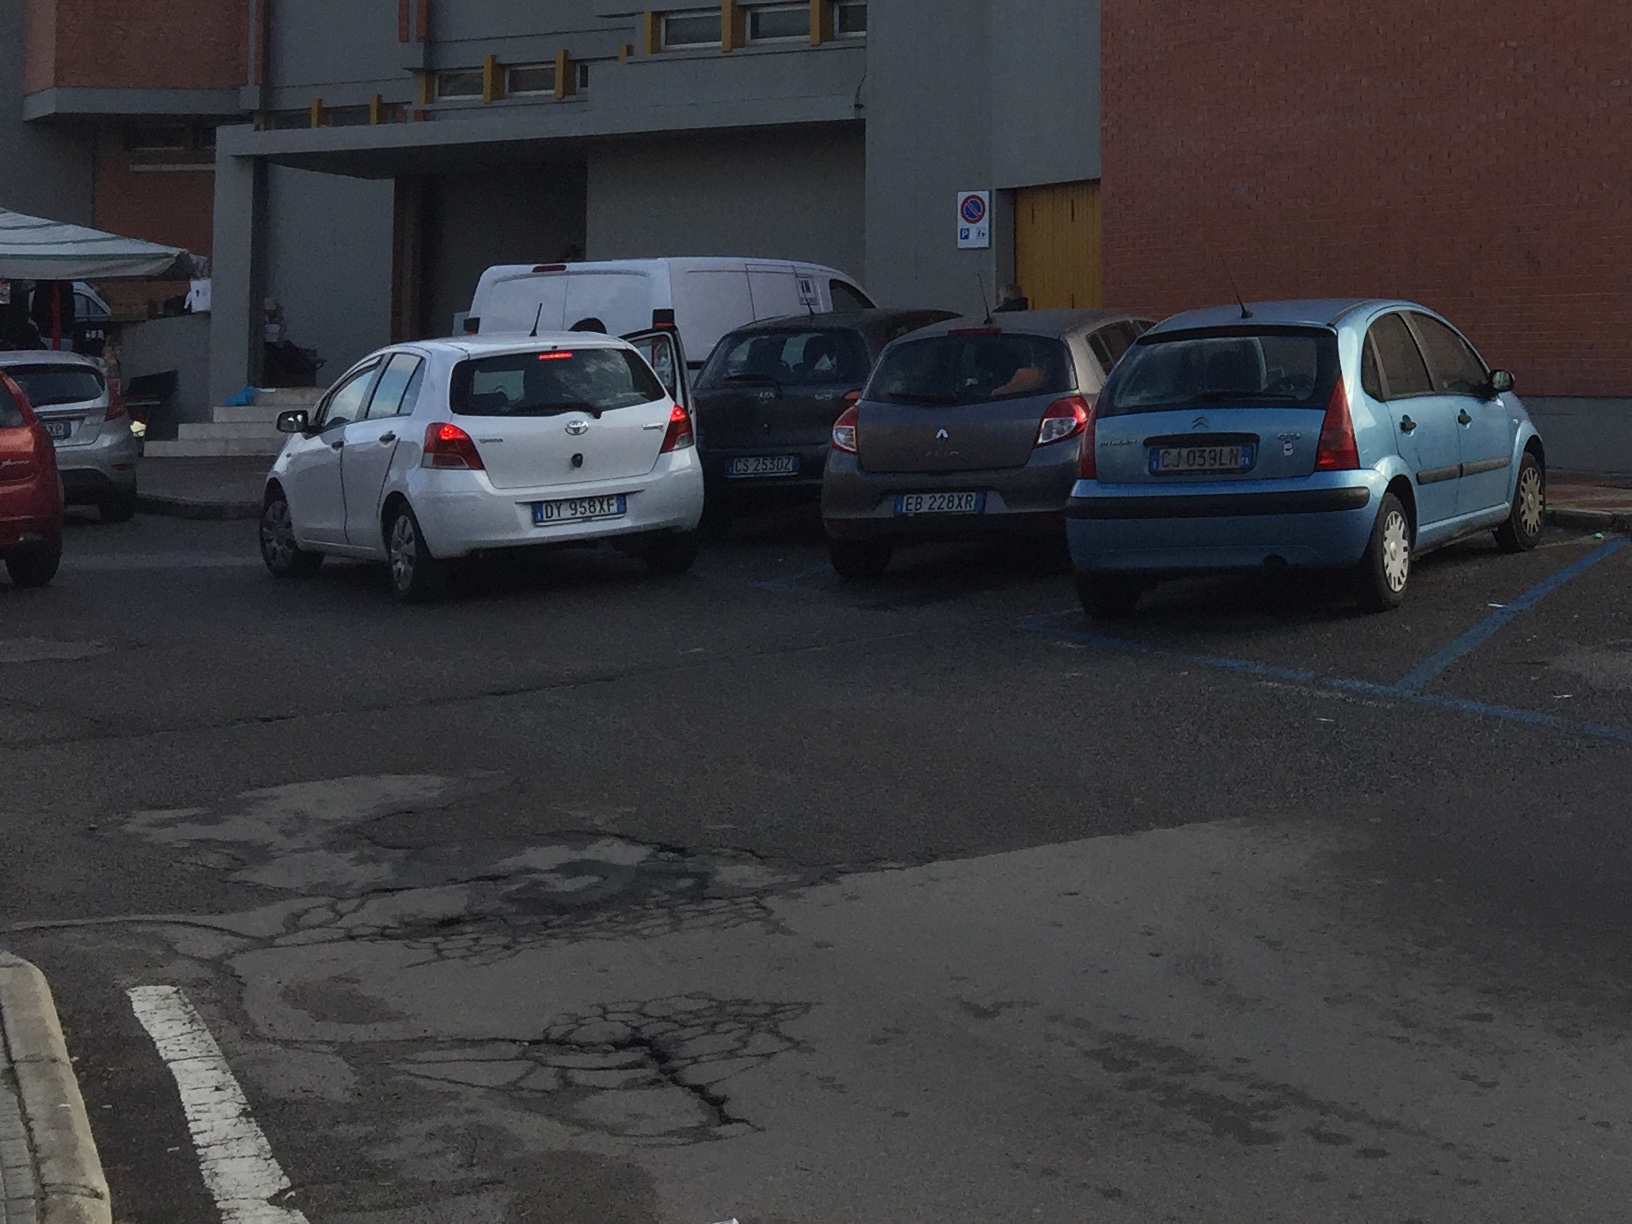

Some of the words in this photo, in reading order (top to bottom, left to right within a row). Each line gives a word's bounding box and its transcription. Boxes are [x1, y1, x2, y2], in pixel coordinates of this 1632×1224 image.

[735, 458, 749, 473] CS
[1161, 449, 1181, 468] CJ
[1187, 447, 1239, 468] 039LN
[545, 502, 562, 519] DY
[569, 497, 615, 516] 958XF
[905, 496, 923, 512] EB
[928, 493, 974, 511] 228XR
